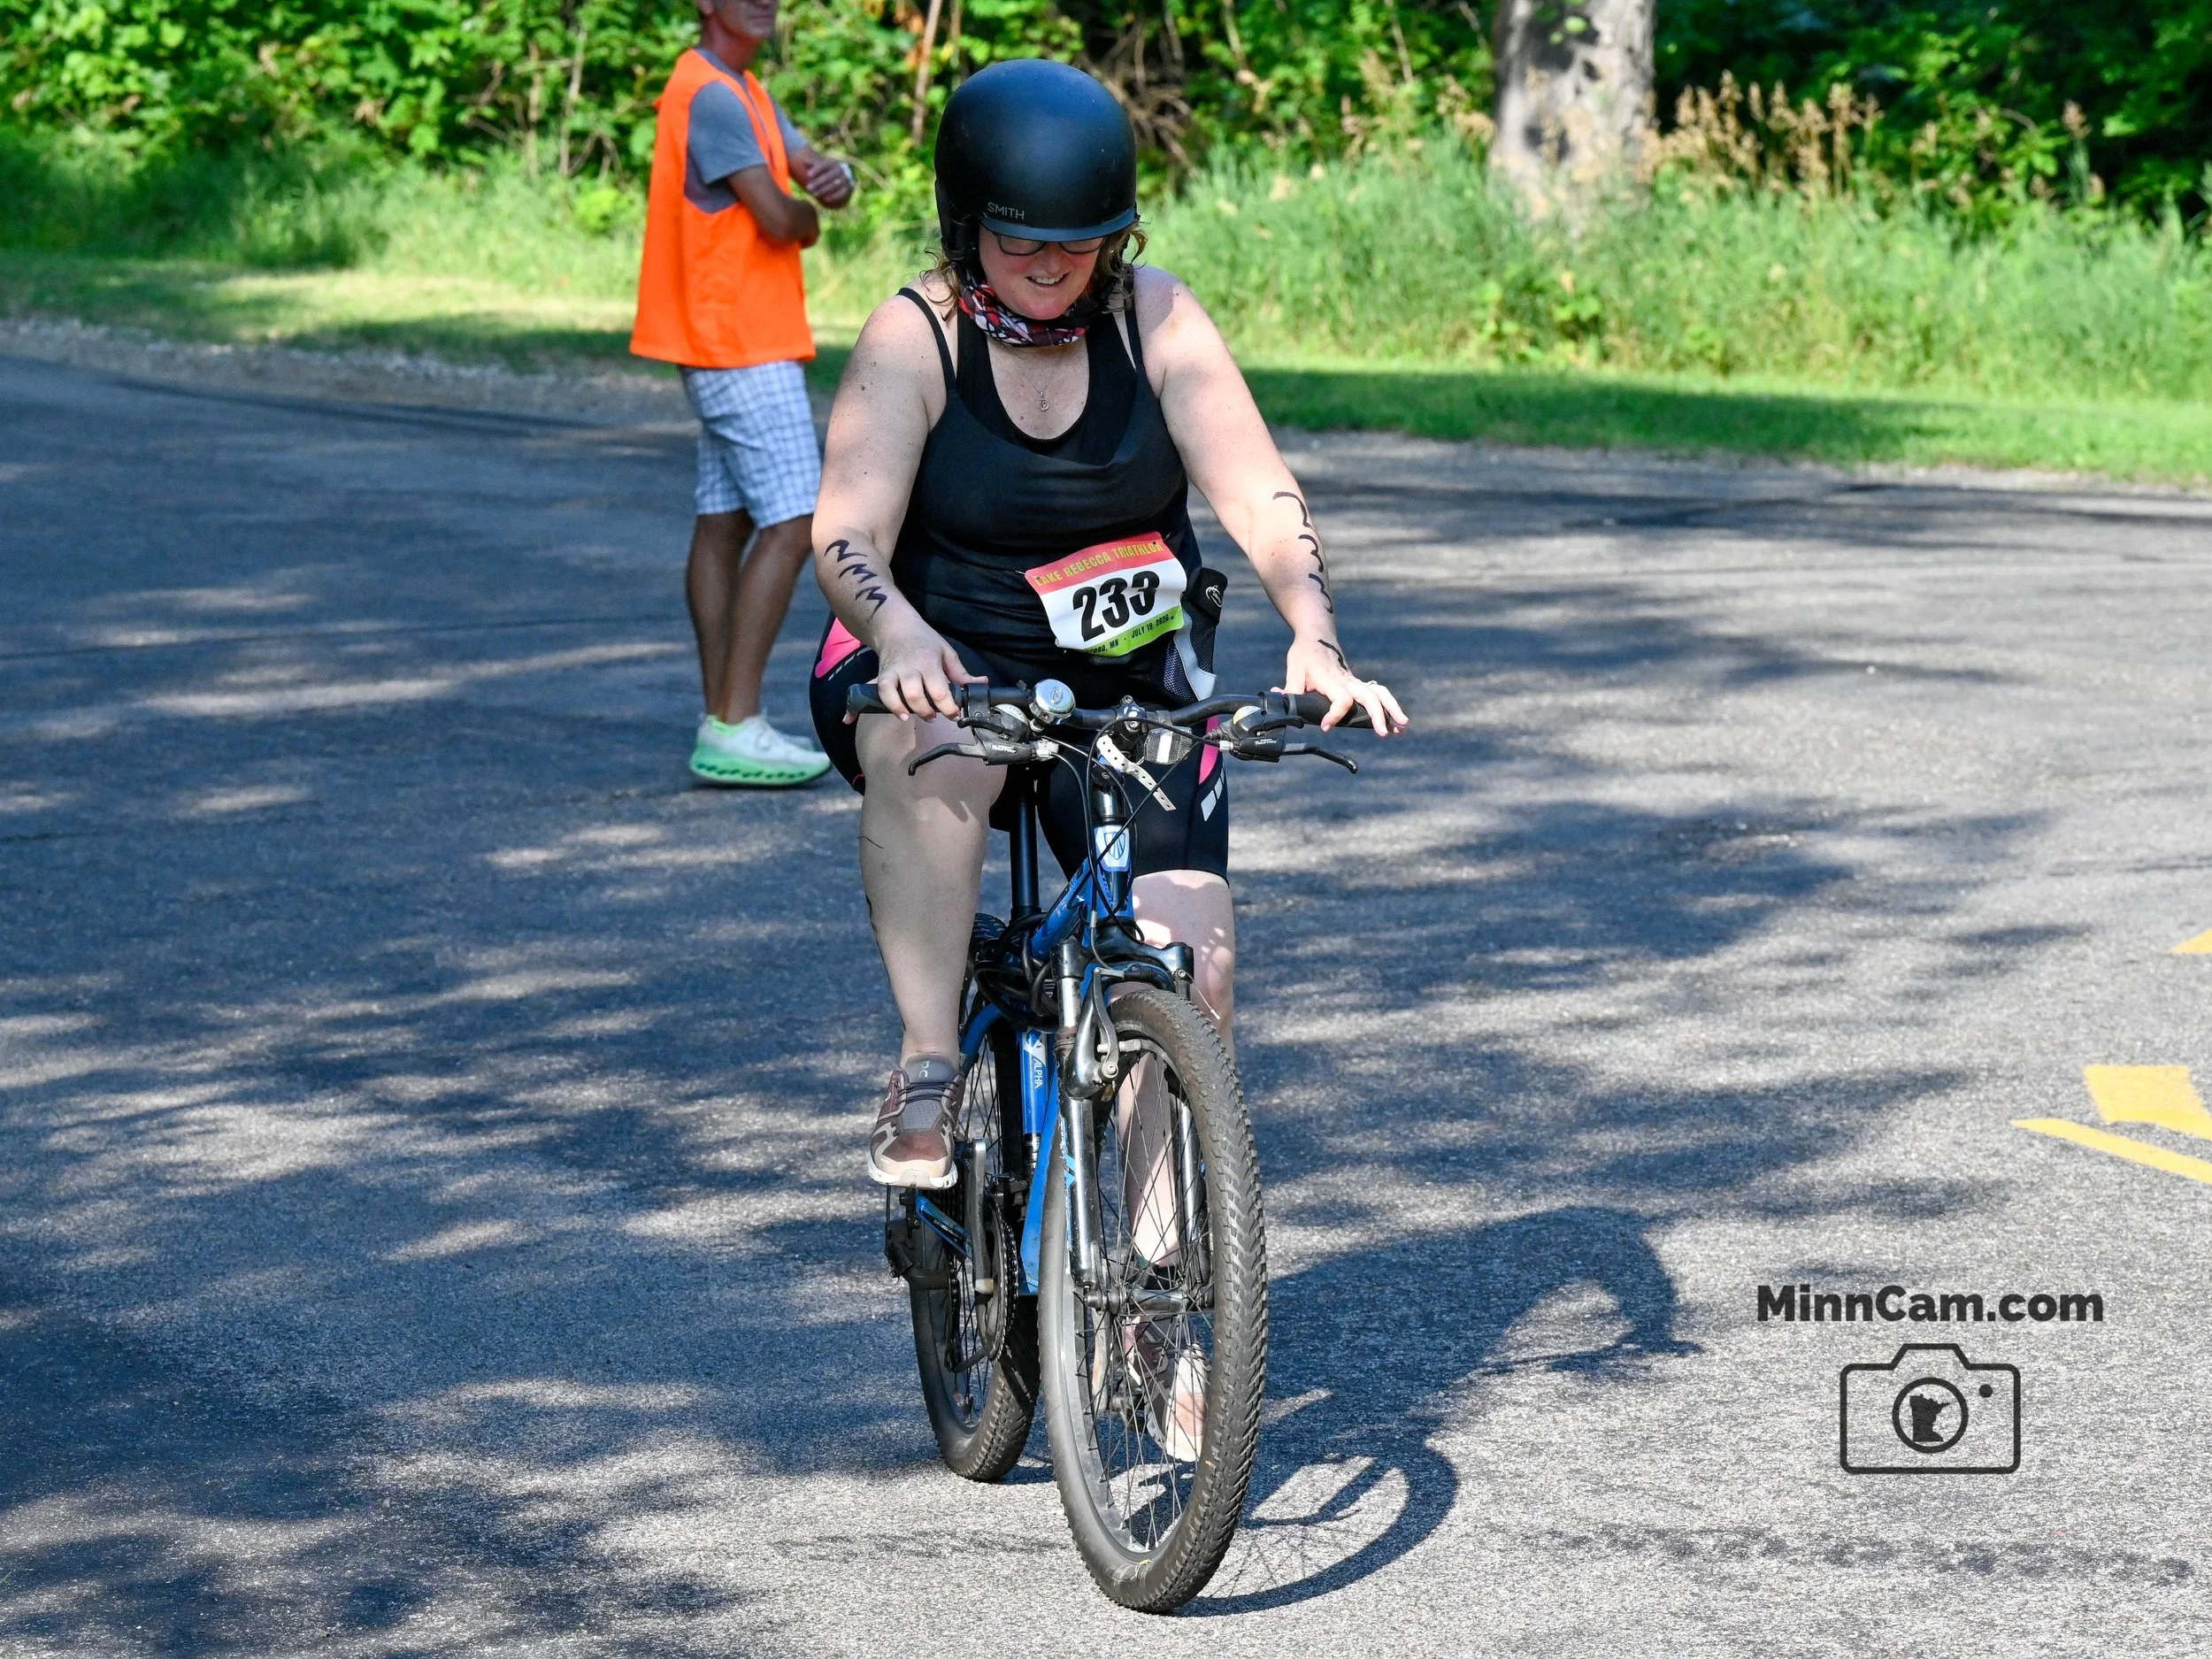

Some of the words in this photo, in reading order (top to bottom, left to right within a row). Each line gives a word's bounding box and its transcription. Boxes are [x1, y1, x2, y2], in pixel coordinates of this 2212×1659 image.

[987, 202, 1025, 219] SMITH
[1034, 571, 1062, 587] LAKE
[1063, 551, 1111, 577] REBECCA
[1111, 541, 1164, 559] TRIATHLON
[1072, 571, 1160, 642] 233
[1131, 626, 1145, 639] JULY
[1033, 1057, 1044, 1089] ALPHA
